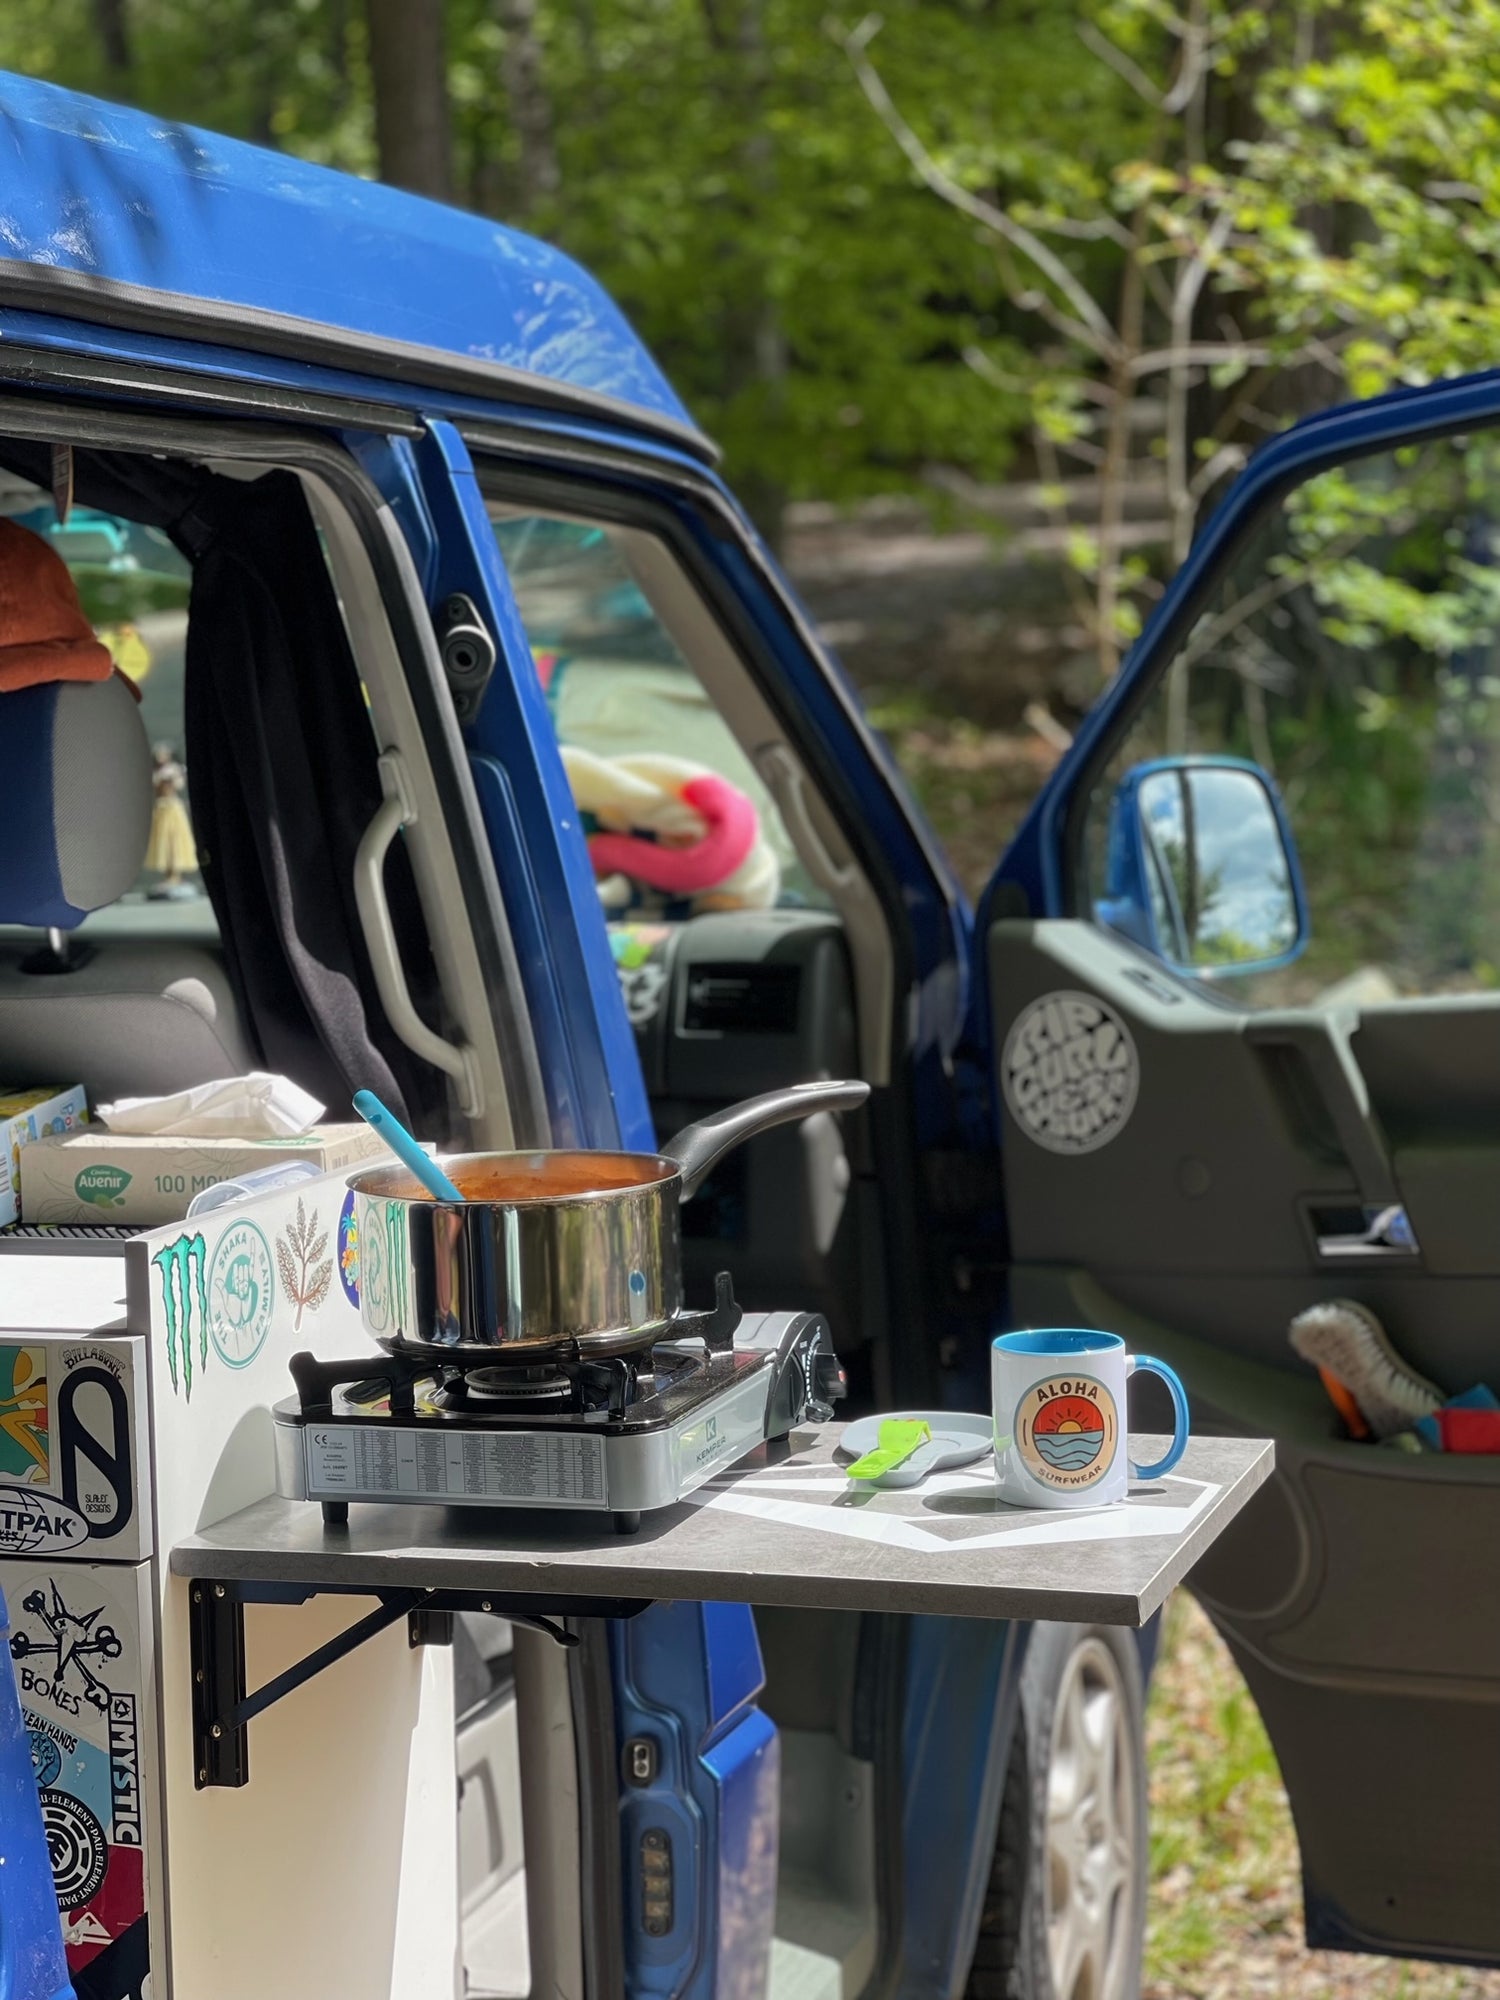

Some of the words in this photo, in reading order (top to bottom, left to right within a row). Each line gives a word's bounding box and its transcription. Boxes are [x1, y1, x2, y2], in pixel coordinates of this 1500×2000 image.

[155, 1175, 185, 1193] 100
[219, 1232, 247, 1269] SHAKA
[255, 1268, 269, 1336] FAMILY
[1037, 1381, 1098, 1402] ALOHA
[696, 1435, 726, 1462] KEMPER
[1038, 1464, 1103, 1484] SURFWEAR
[21, 1667, 82, 1716] BONES
[22, 1706, 48, 1732] LEAN
[46, 1724, 78, 1755] HANDS
[111, 1723, 139, 1842] MYSTIC
[51, 1795, 93, 1827] ELEMENT
[92, 1828, 104, 1852] PAU
[80, 1855, 104, 1899] ELEMENT
